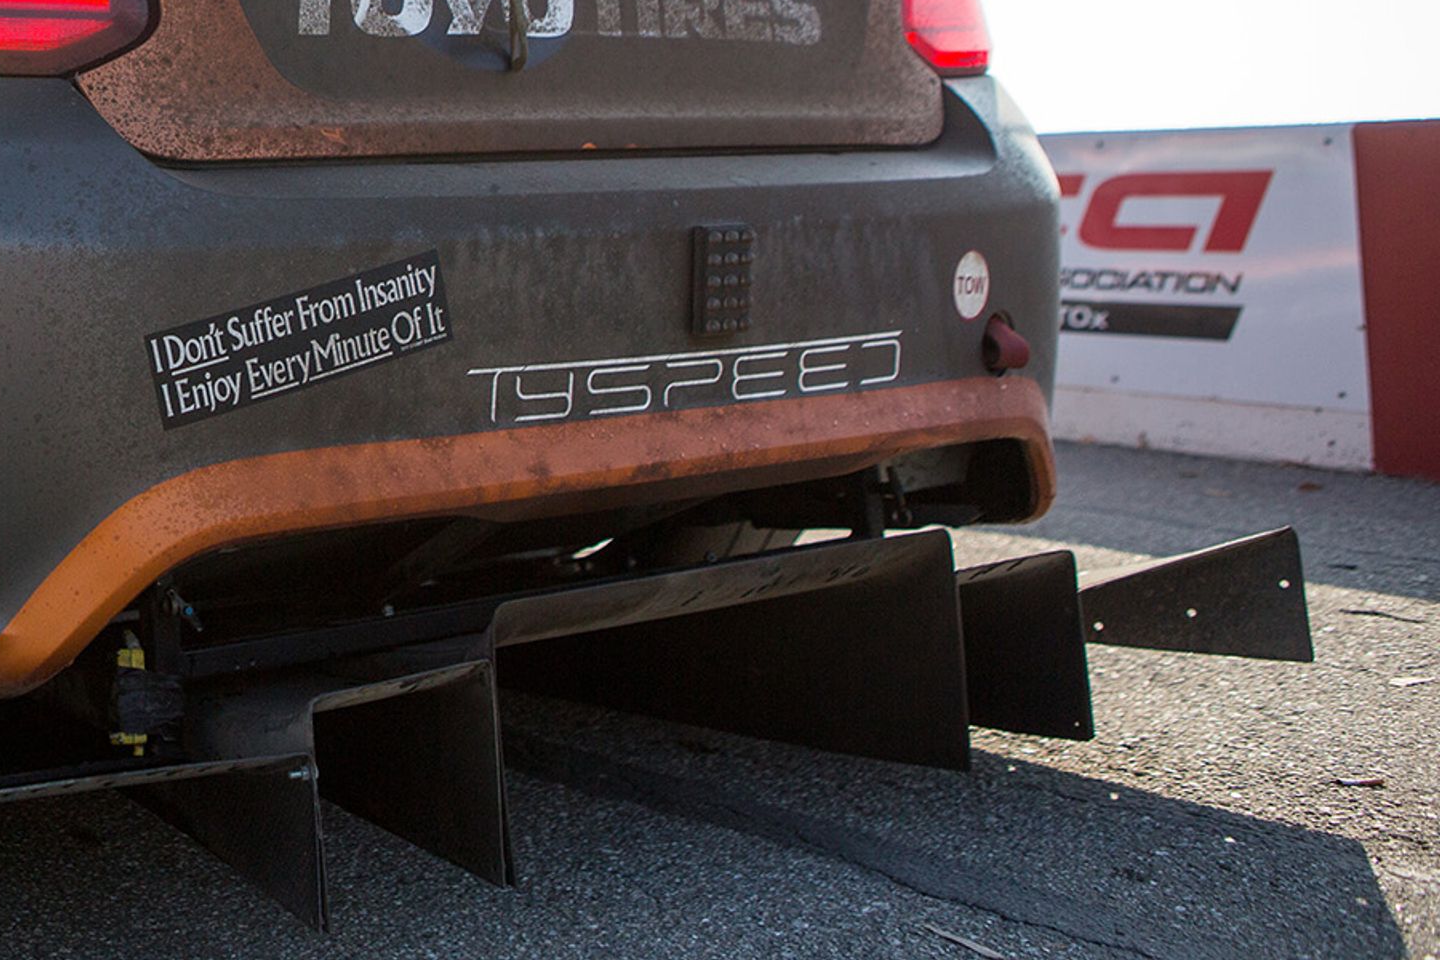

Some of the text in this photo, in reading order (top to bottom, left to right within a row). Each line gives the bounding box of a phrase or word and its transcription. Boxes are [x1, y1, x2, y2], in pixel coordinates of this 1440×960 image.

[151, 264, 436, 373] I Don't Suffer From Insanity
[957, 275, 987, 295] TOW
[161, 383, 174, 418] I
[175, 372, 242, 414] Enjoy
[246, 350, 311, 393] Every
[310, 327, 391, 372] Minute
[391, 306, 422, 344] Of
[426, 302, 446, 335] It
[467, 329, 903, 423] TYSPEED
